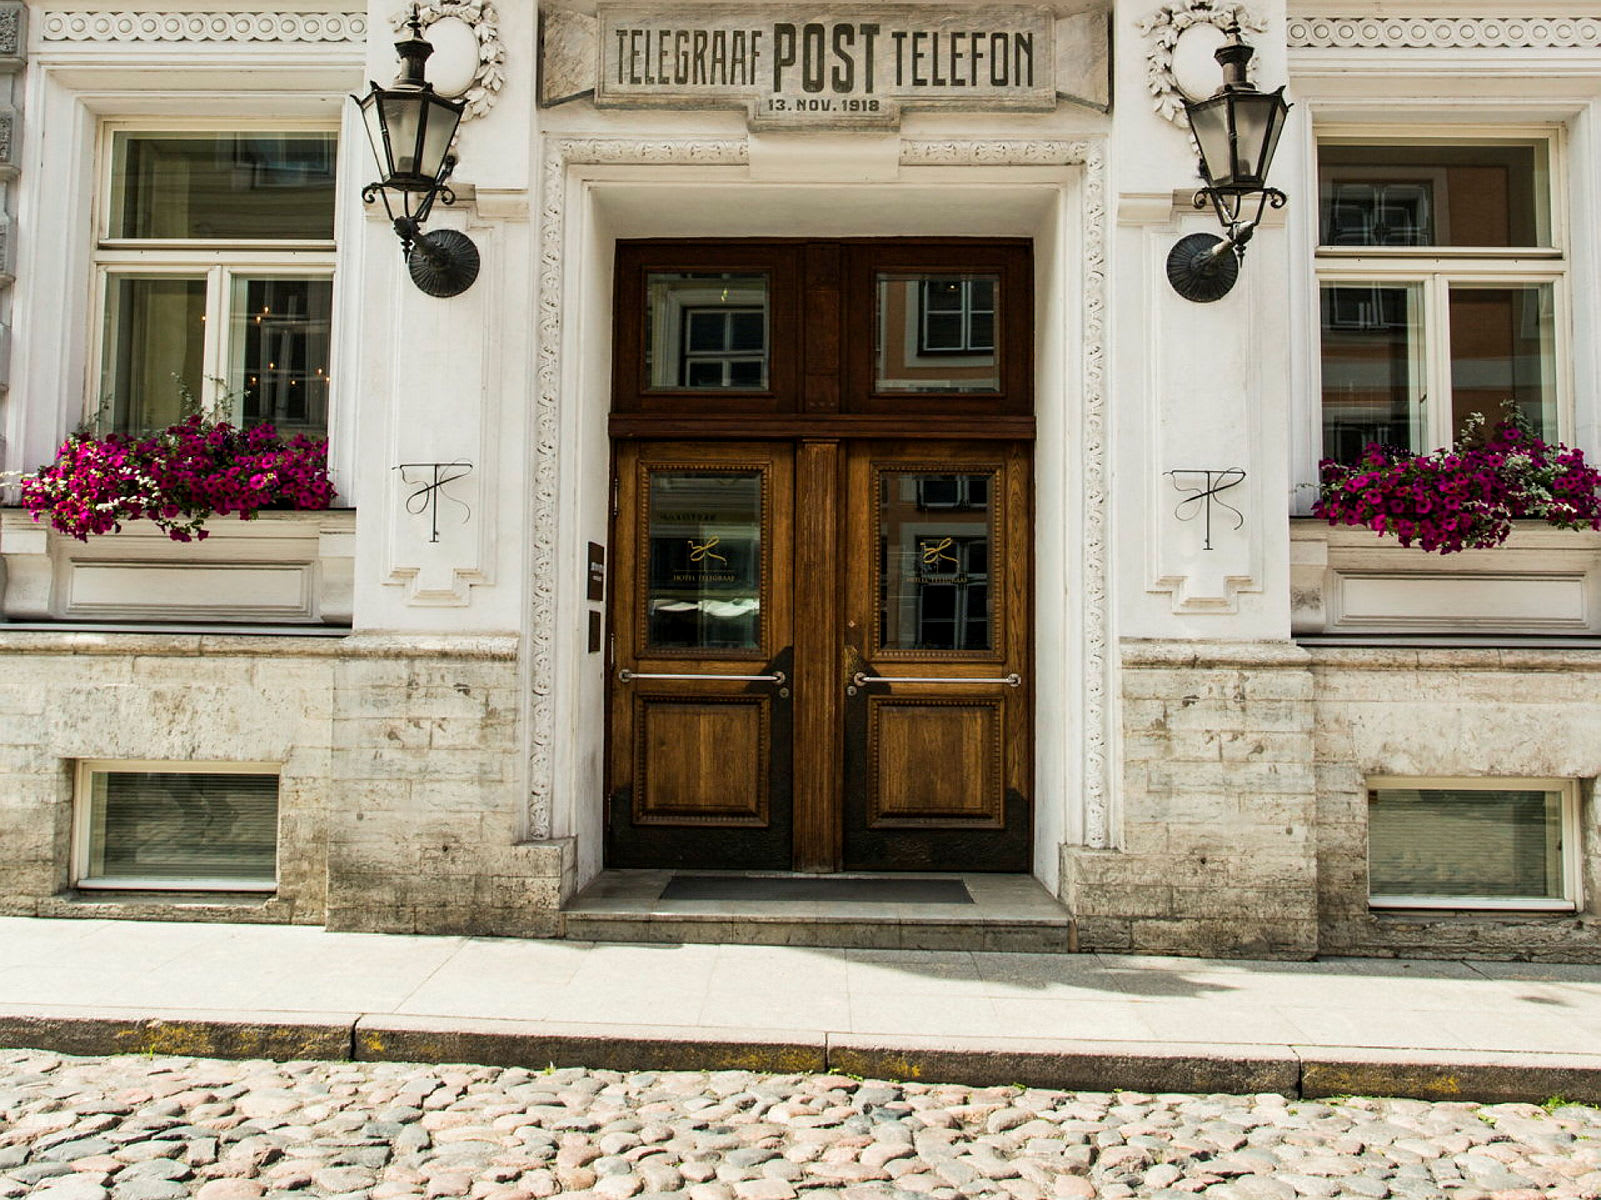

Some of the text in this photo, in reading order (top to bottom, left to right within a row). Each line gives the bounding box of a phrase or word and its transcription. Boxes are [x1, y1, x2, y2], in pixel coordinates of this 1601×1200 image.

[615, 23, 1034, 93] TELEGRAAF POST TELEFON
[768, 99, 880, 111] 13. NOV. 1918
